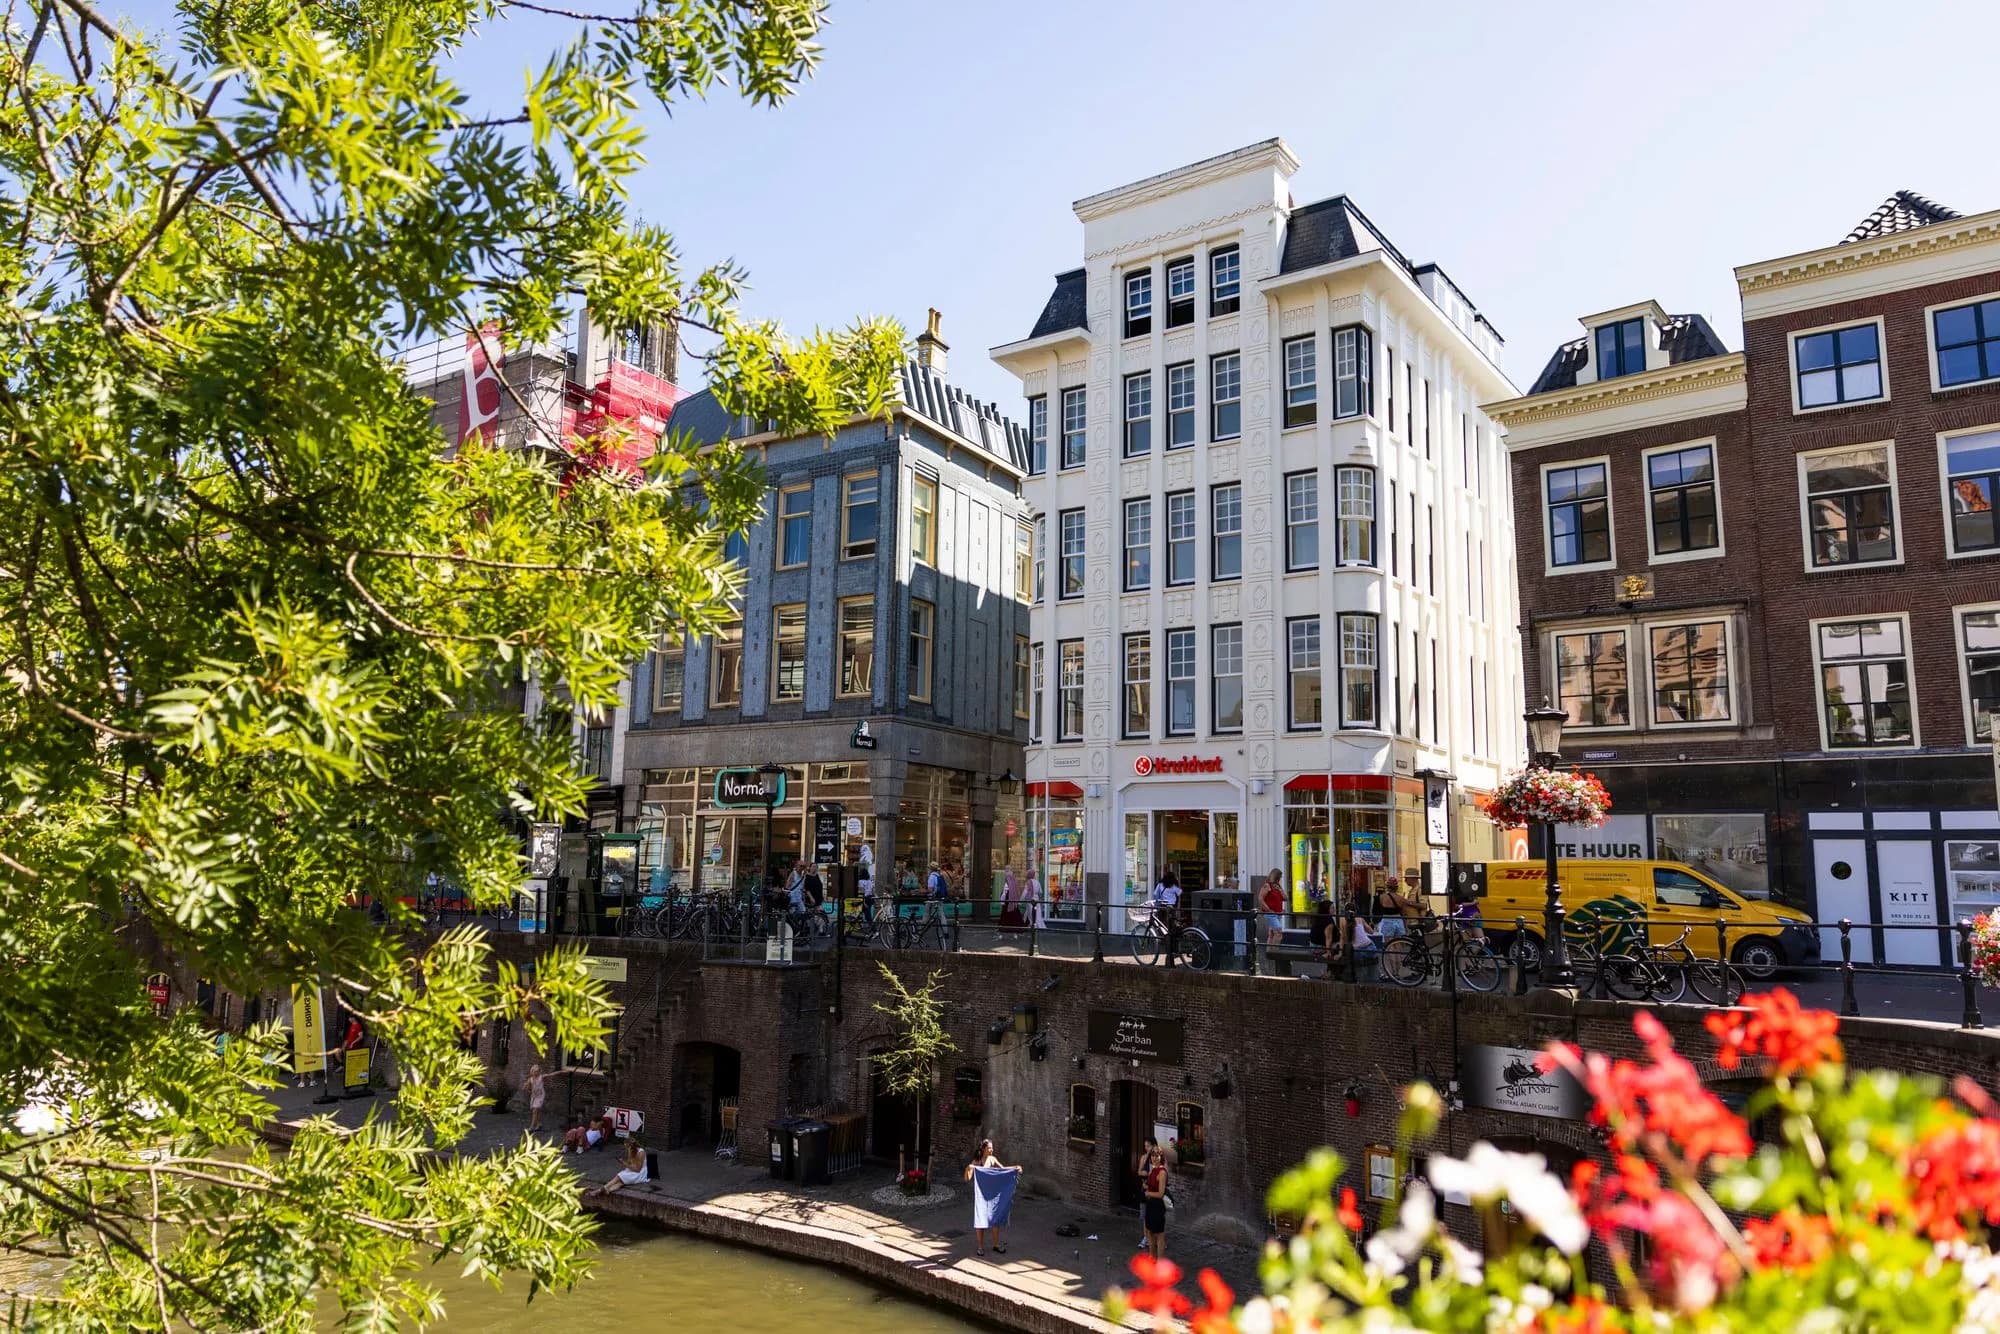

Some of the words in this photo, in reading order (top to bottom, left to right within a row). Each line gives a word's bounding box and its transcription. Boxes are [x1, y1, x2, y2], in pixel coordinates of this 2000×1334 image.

[856, 737, 873, 747] Normal
[1155, 756, 1223, 773] Kruidvat
[724, 776, 766, 797] Norma
[1556, 843, 1577, 858] TE
[1582, 843, 1642, 859] HUUR
[1889, 892, 1929, 902] KITT
[1114, 1028, 1152, 1046] Sarban
[1506, 1083, 1528, 1100] Silk
[1496, 1098, 1519, 1107] CENTRAL
[1520, 1101, 1537, 1109] ASIAN
[1537, 1103, 1560, 1113] CUISINE
